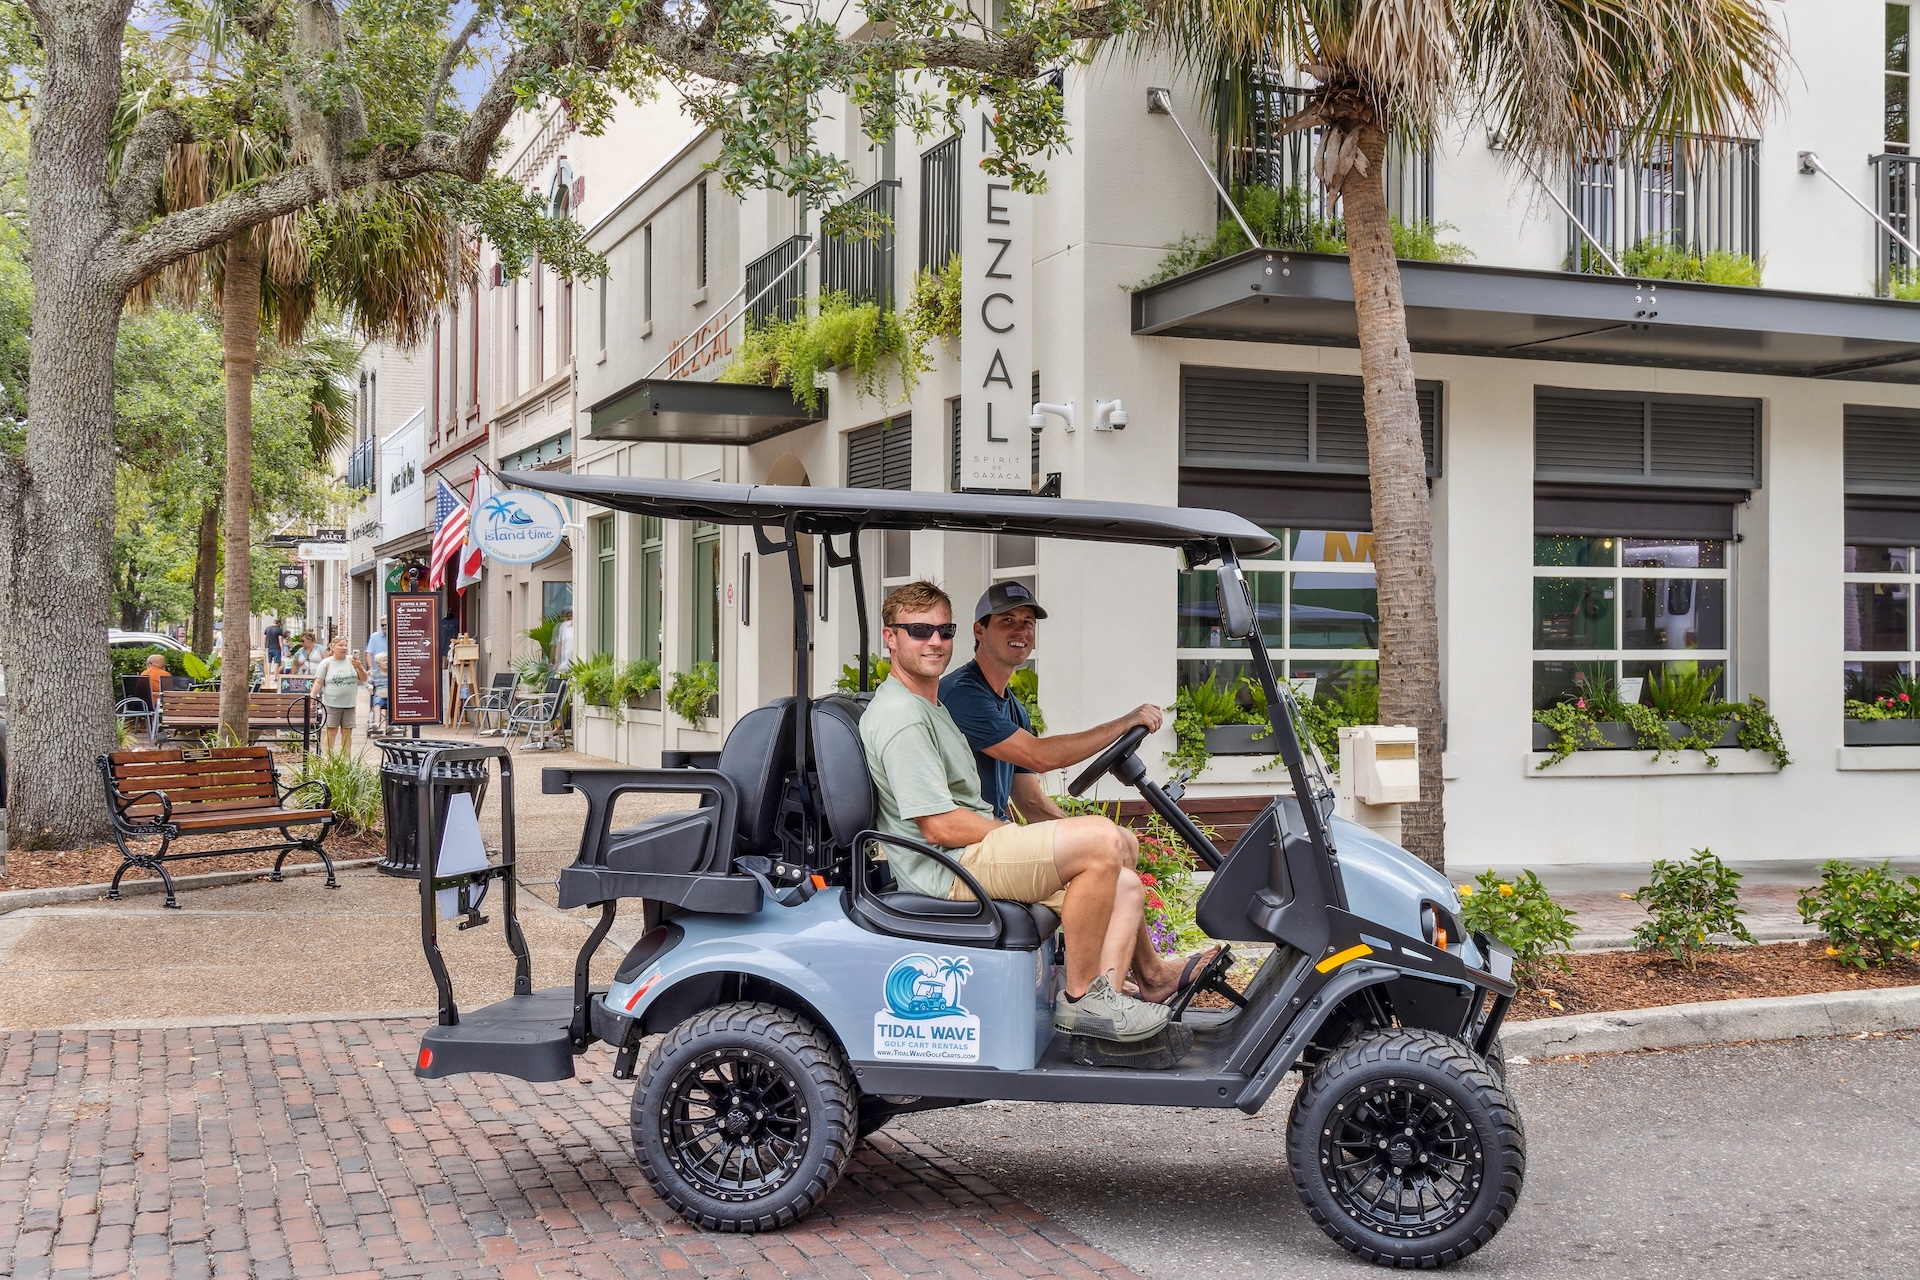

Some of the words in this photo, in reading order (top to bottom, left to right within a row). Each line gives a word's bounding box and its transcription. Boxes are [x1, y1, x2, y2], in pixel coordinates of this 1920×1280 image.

[669, 314, 732, 380] MEZCAL
[974, 456, 1020, 464] SPIRIT
[484, 530, 525, 541] island
[528, 529, 554, 540] time
[492, 548, 510, 559] Cream
[878, 1024, 926, 1038] TIDAL
[931, 1026, 976, 1040] WAVE
[877, 1050, 976, 1059] www.TidalWaveGolfCarts.com
